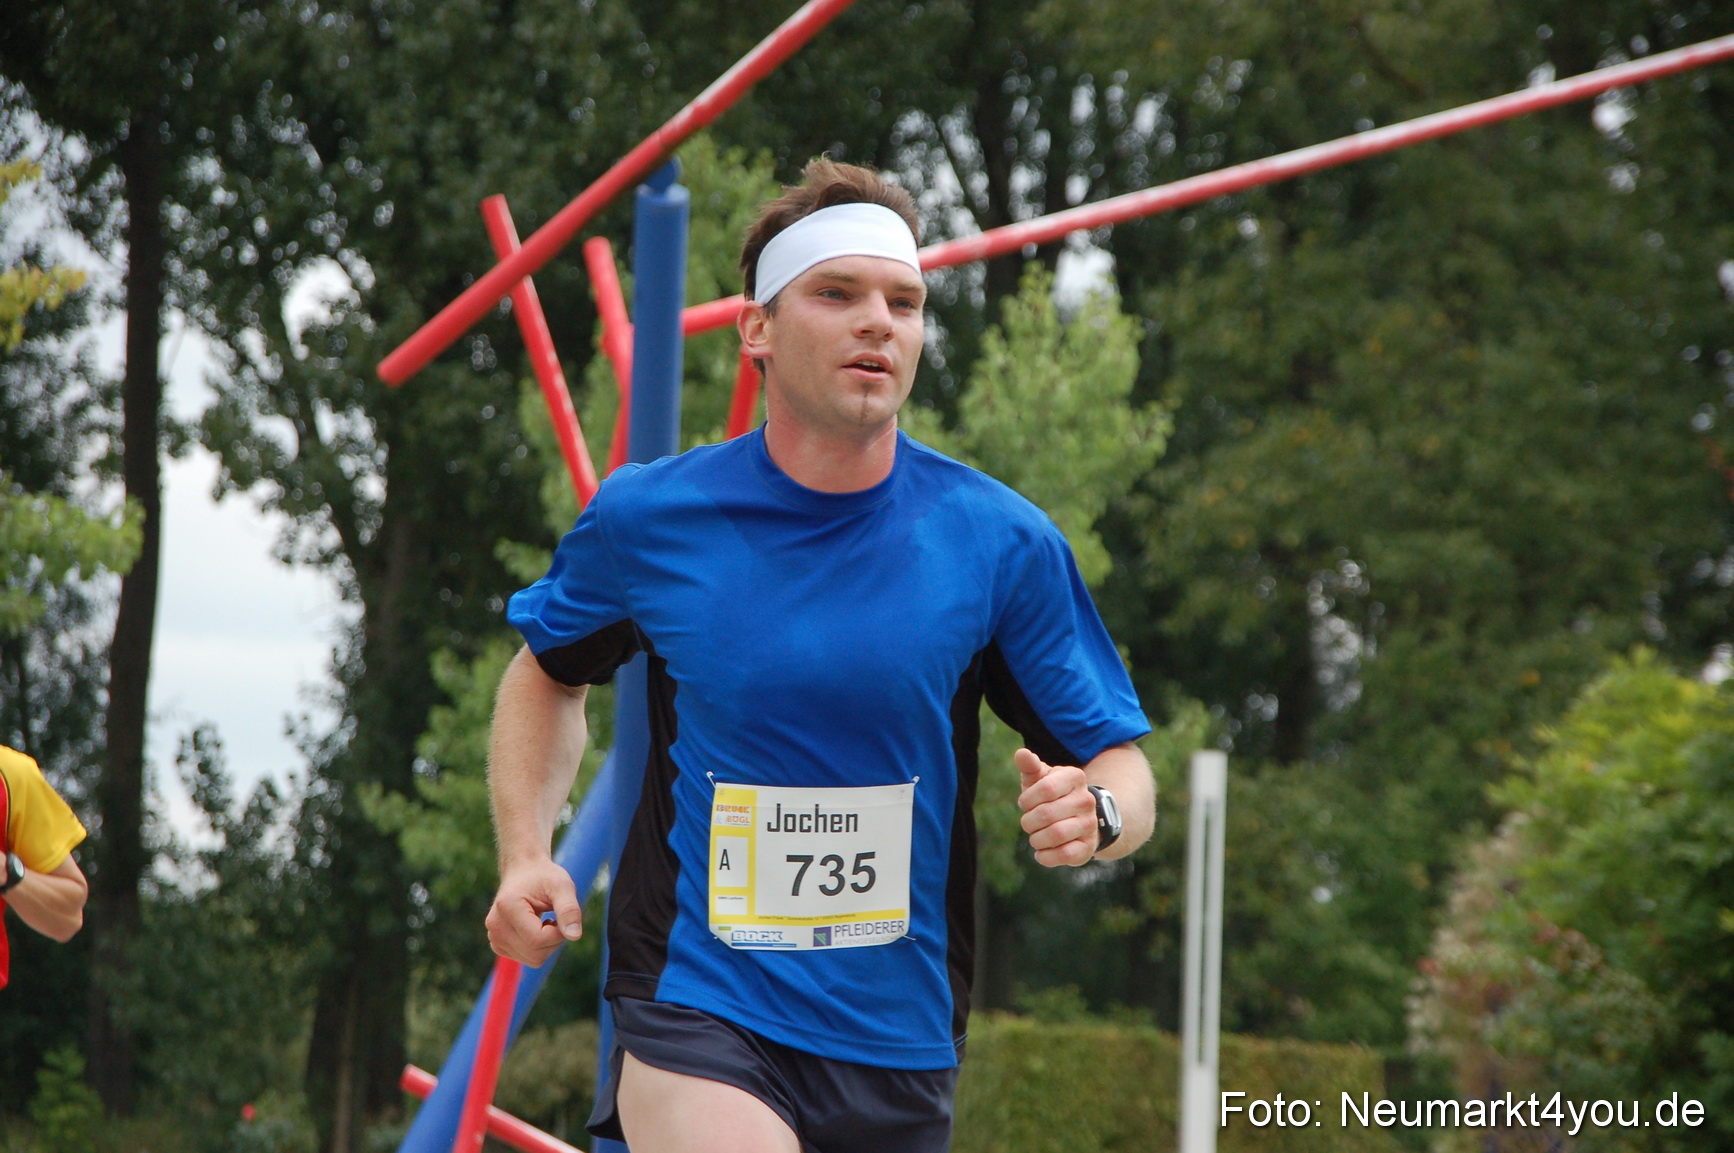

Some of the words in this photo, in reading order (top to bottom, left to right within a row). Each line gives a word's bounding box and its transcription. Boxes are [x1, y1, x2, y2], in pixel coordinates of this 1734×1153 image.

[767, 803, 859, 833] Jochen
[719, 848, 731, 871] A
[786, 851, 877, 897] 735
[731, 930, 784, 943] BOCK
[834, 920, 905, 938] PFLEIDERER
